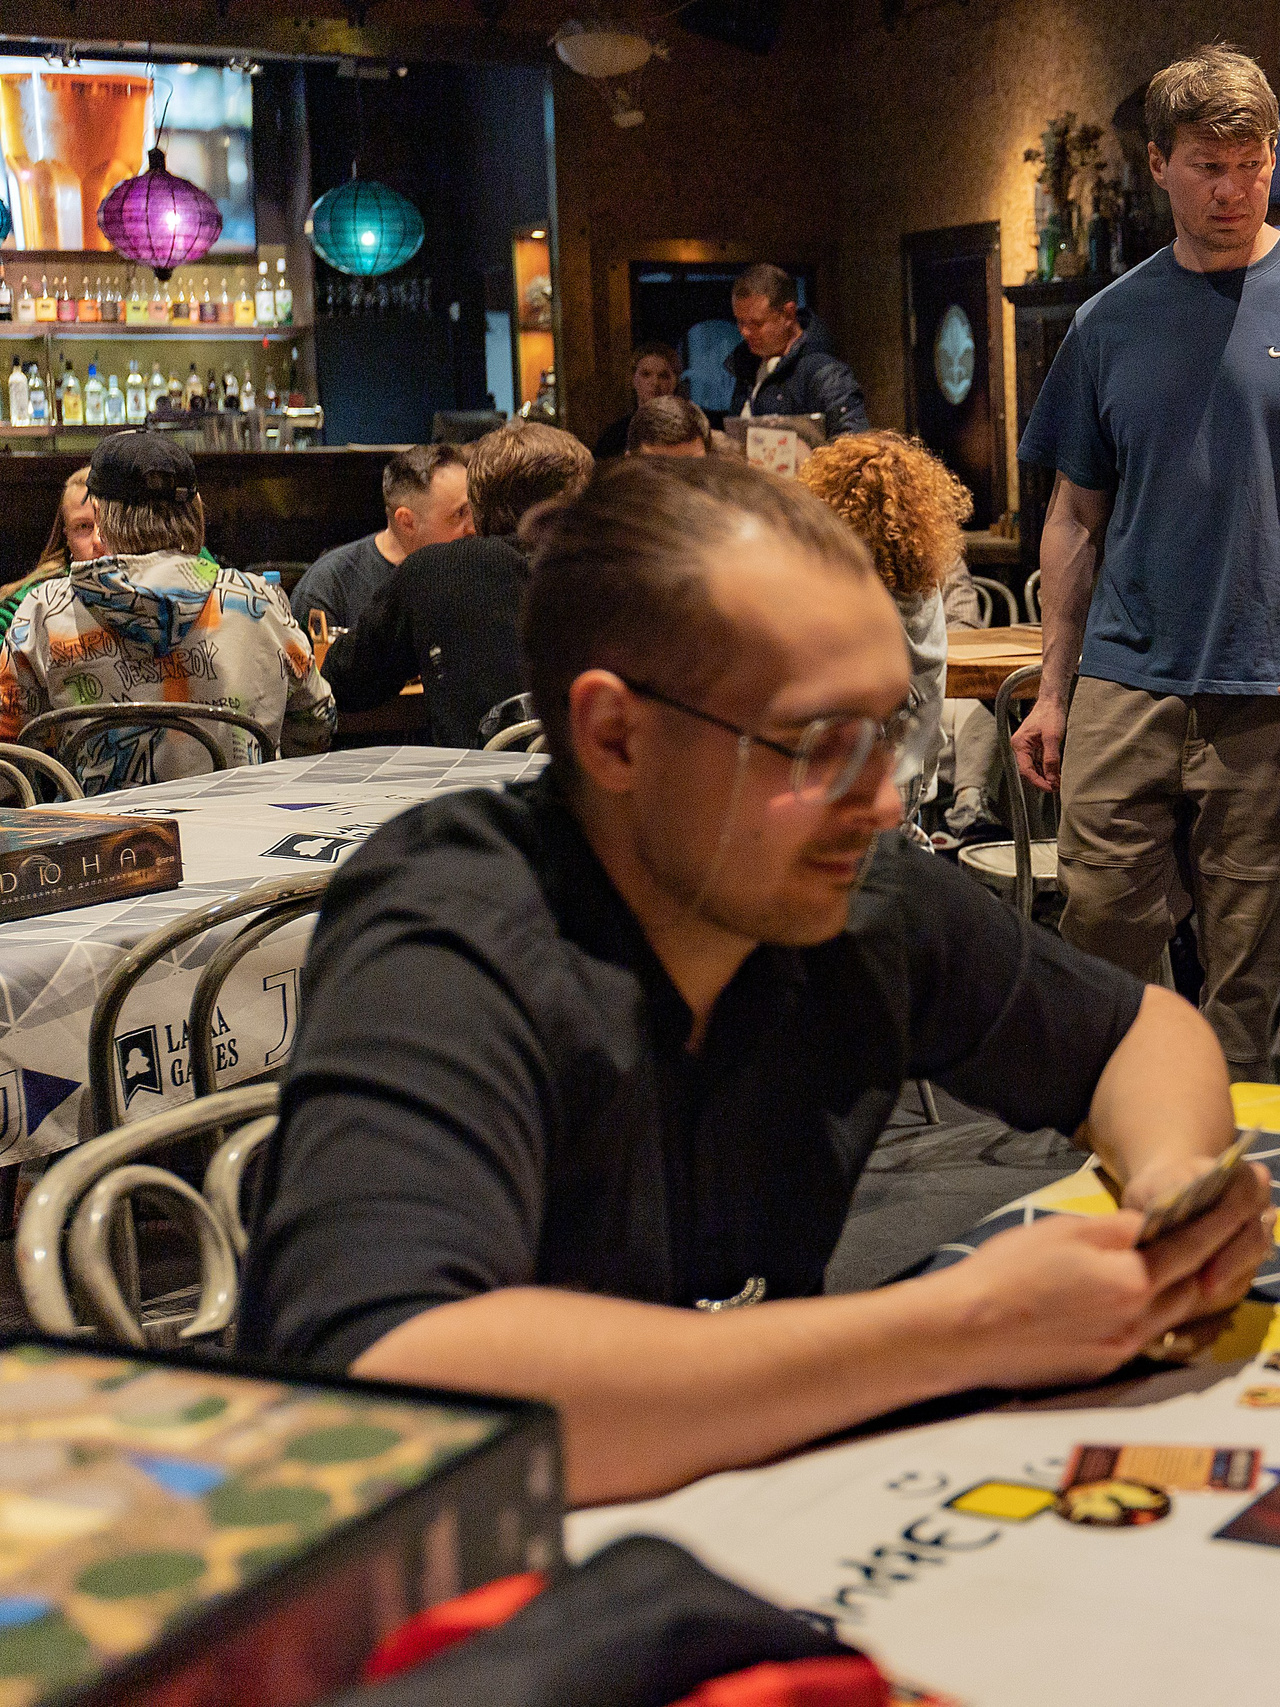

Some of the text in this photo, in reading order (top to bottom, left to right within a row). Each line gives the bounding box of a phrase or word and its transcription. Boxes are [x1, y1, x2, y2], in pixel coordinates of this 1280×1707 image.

[63, 672, 103, 704] TO
[114, 639, 219, 691] DESTROY
[165, 1006, 231, 1053] LAA
[170, 1038, 239, 1087] GAES
